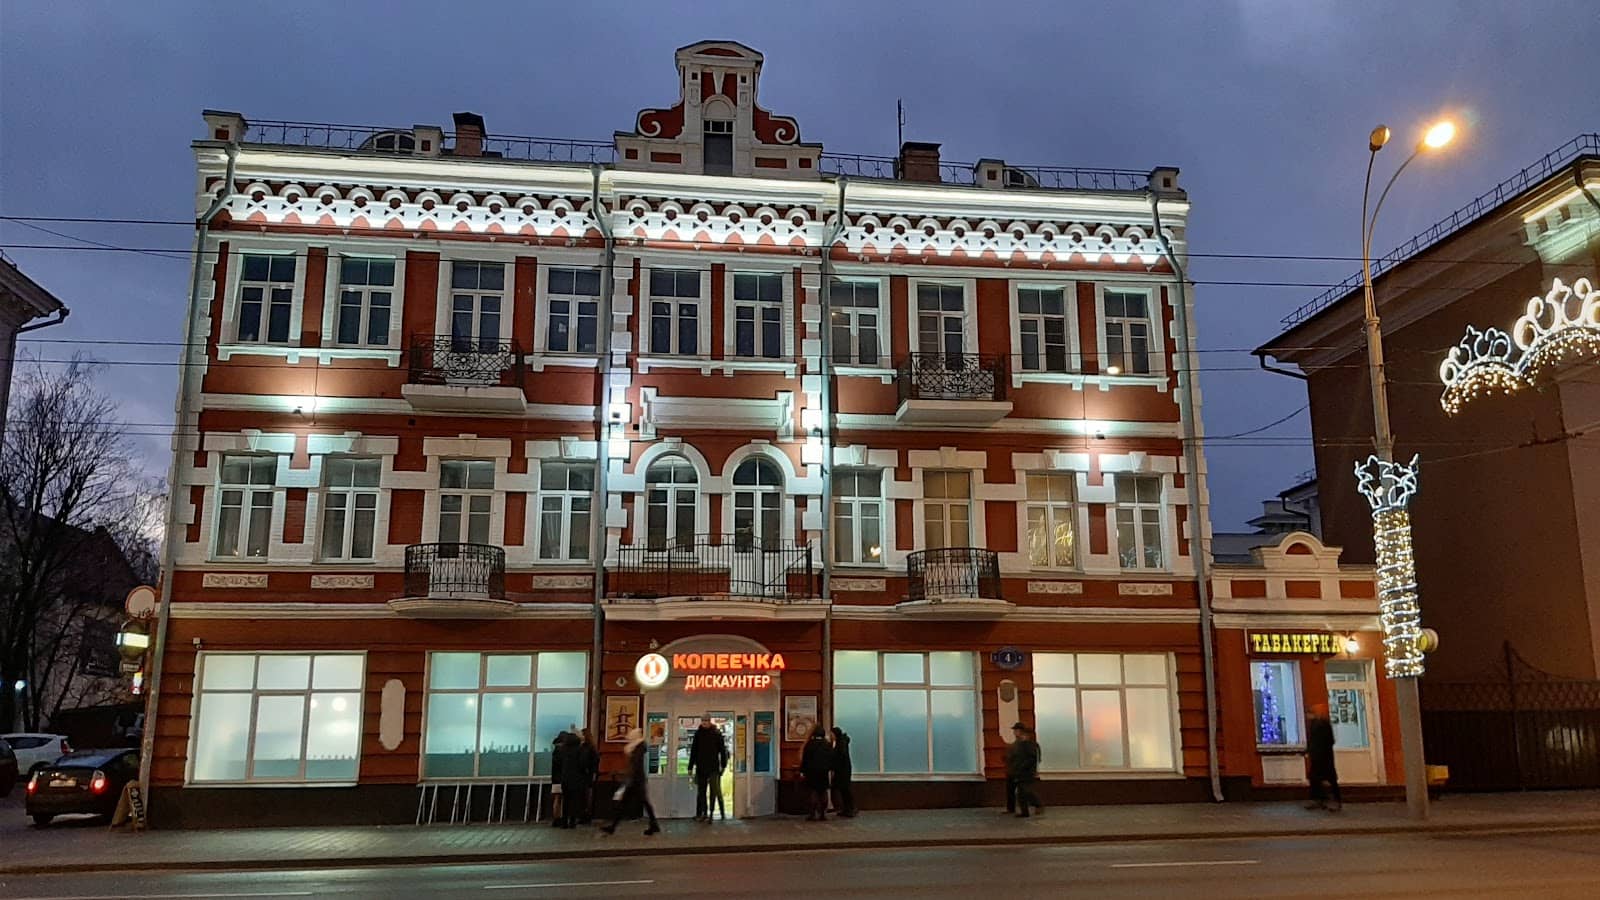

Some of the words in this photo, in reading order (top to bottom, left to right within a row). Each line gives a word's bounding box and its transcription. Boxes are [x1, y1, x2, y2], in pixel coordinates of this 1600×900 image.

[1252, 633, 1341, 653] ТАБАКЕРКА
[673, 653, 785, 669] КОПЕЕЧКА
[685, 674, 771, 690] ДИСКАУНТЕР
